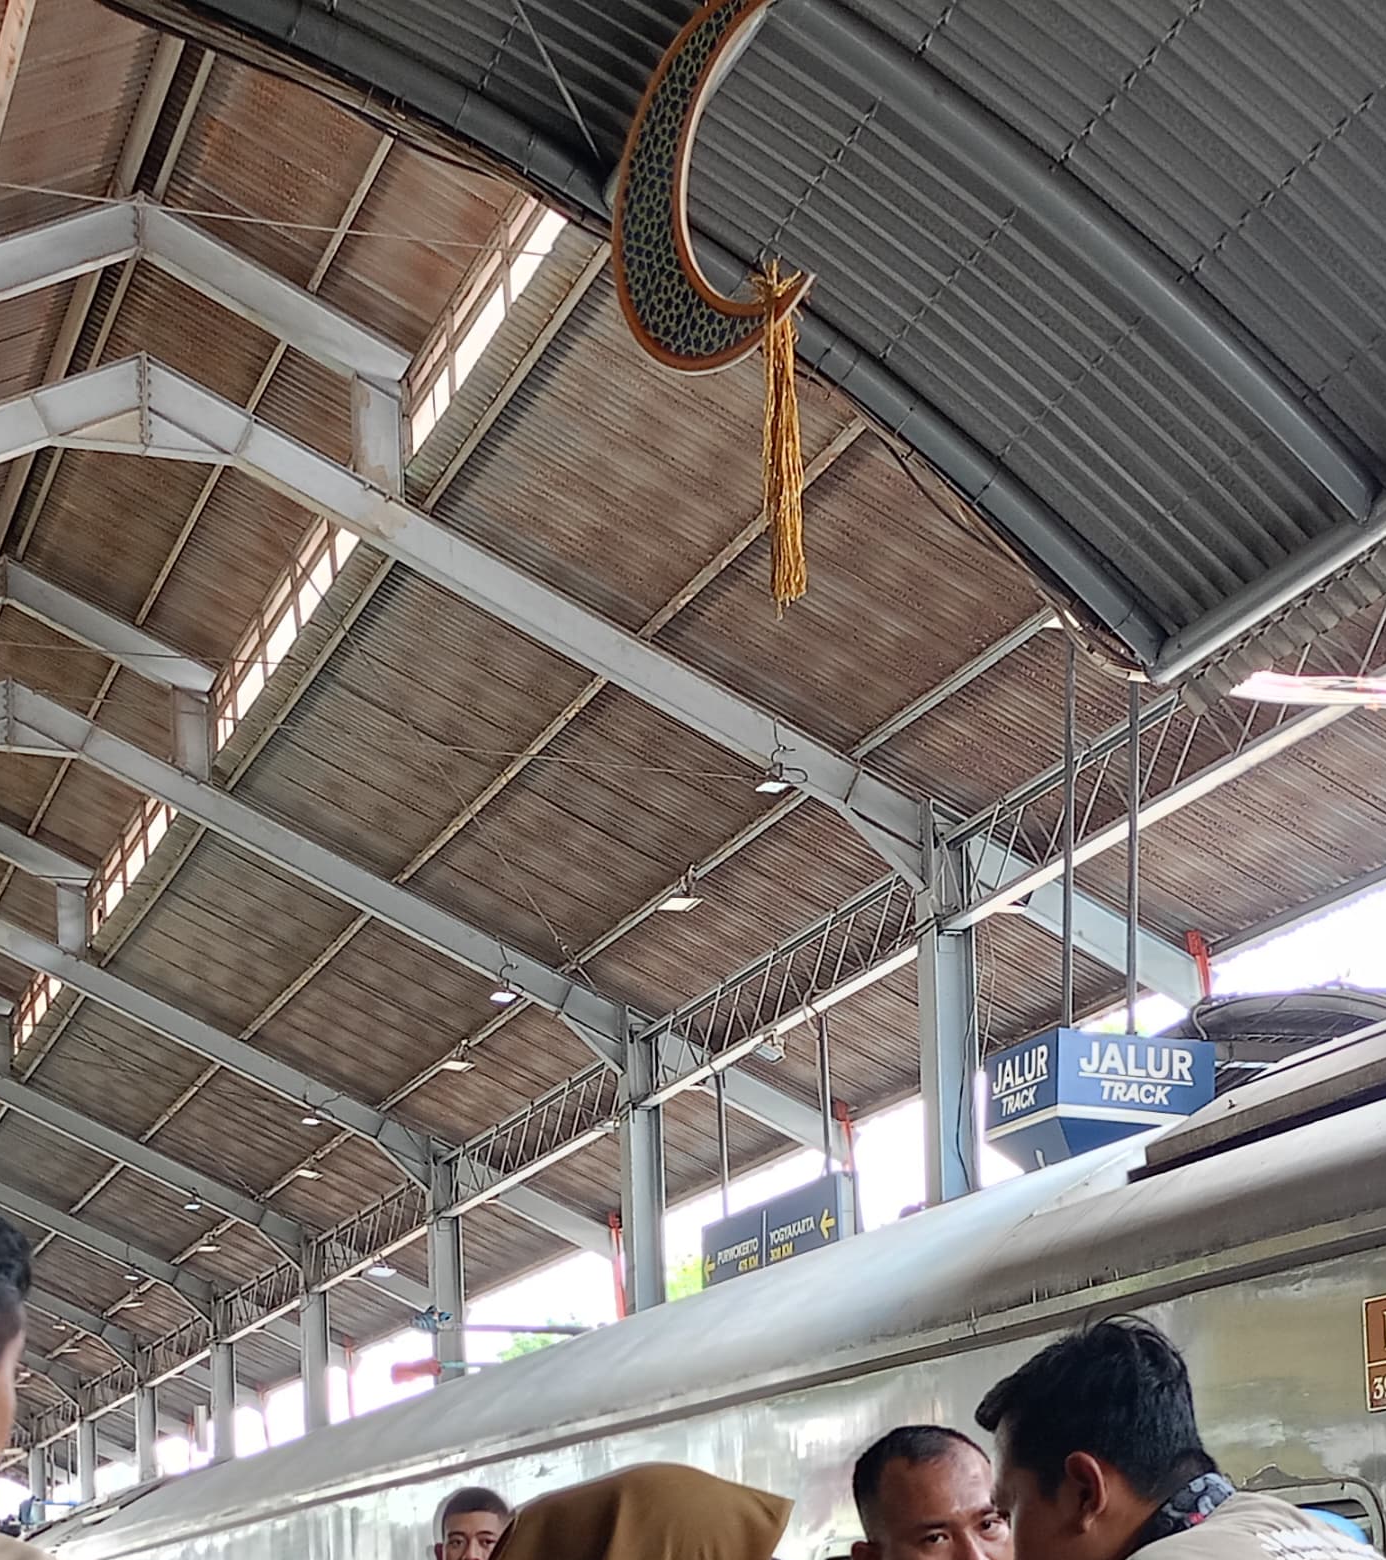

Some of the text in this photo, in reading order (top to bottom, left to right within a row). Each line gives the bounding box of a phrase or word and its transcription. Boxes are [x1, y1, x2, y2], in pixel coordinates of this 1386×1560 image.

[993, 1044, 1048, 1094] JALUR
[1079, 1041, 1194, 1081] JALUR
[1001, 1087, 1036, 1116] TRACK
[1101, 1080, 1172, 1105] TRACK
[769, 1216, 815, 1245] YOGYAKARTA
[717, 1237, 759, 1265] PURWOKERTO
